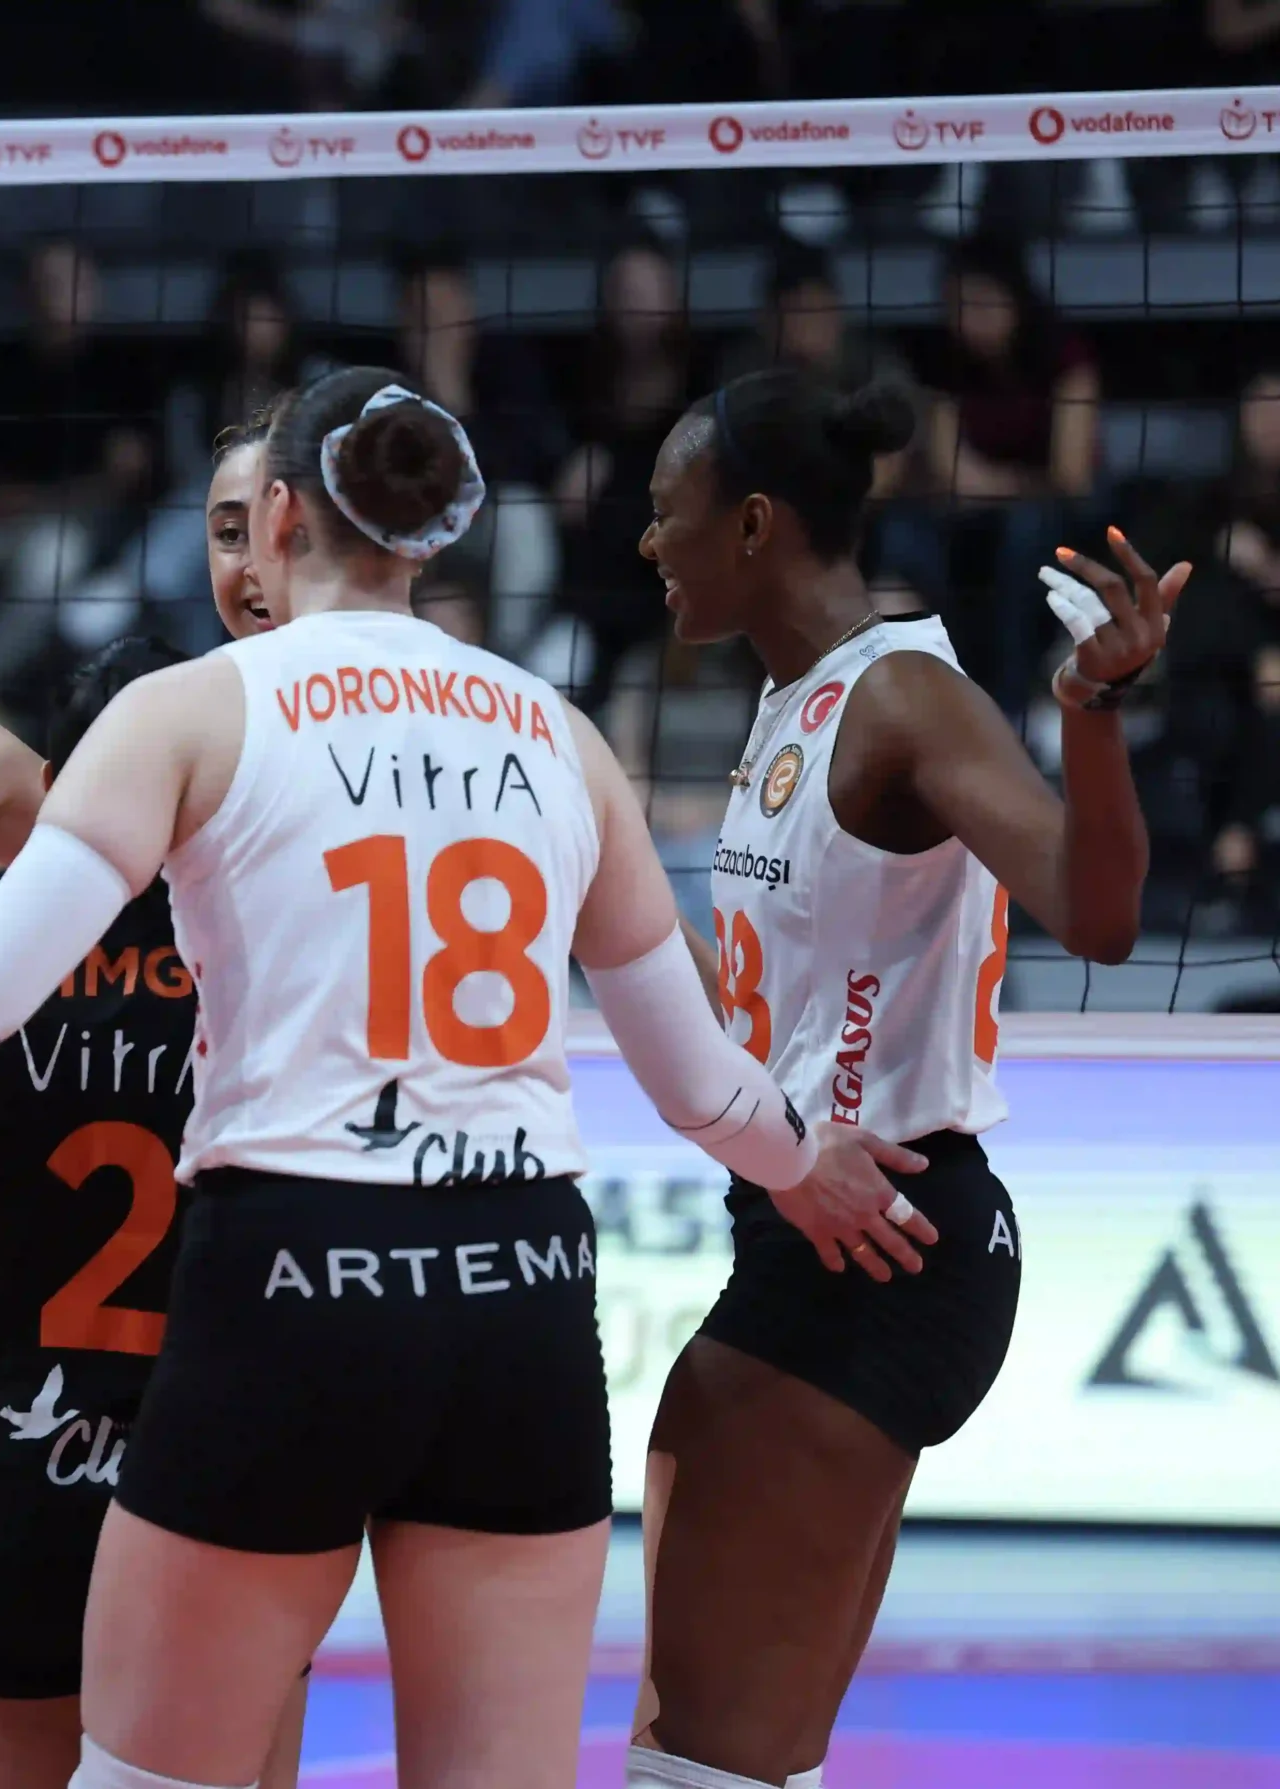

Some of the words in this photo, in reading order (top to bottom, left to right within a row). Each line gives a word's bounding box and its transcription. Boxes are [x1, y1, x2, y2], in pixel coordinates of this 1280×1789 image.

[748, 120, 851, 144] vodafone
[934, 120, 985, 145] TVF
[1071, 110, 1176, 134] vodafone
[131, 136, 229, 158] vodafone
[308, 137, 357, 159] TVF
[436, 131, 536, 153] vodafone
[616, 129, 667, 152] TVF
[6, 143, 52, 164] TVF
[276, 667, 557, 757] VORONKOVA
[323, 834, 551, 1067] 18
[831, 969, 880, 1126] EGASUS
[413, 1126, 545, 1187] Club
[40, 1120, 177, 1356] 2
[265, 1233, 595, 1298] ARTEMA
